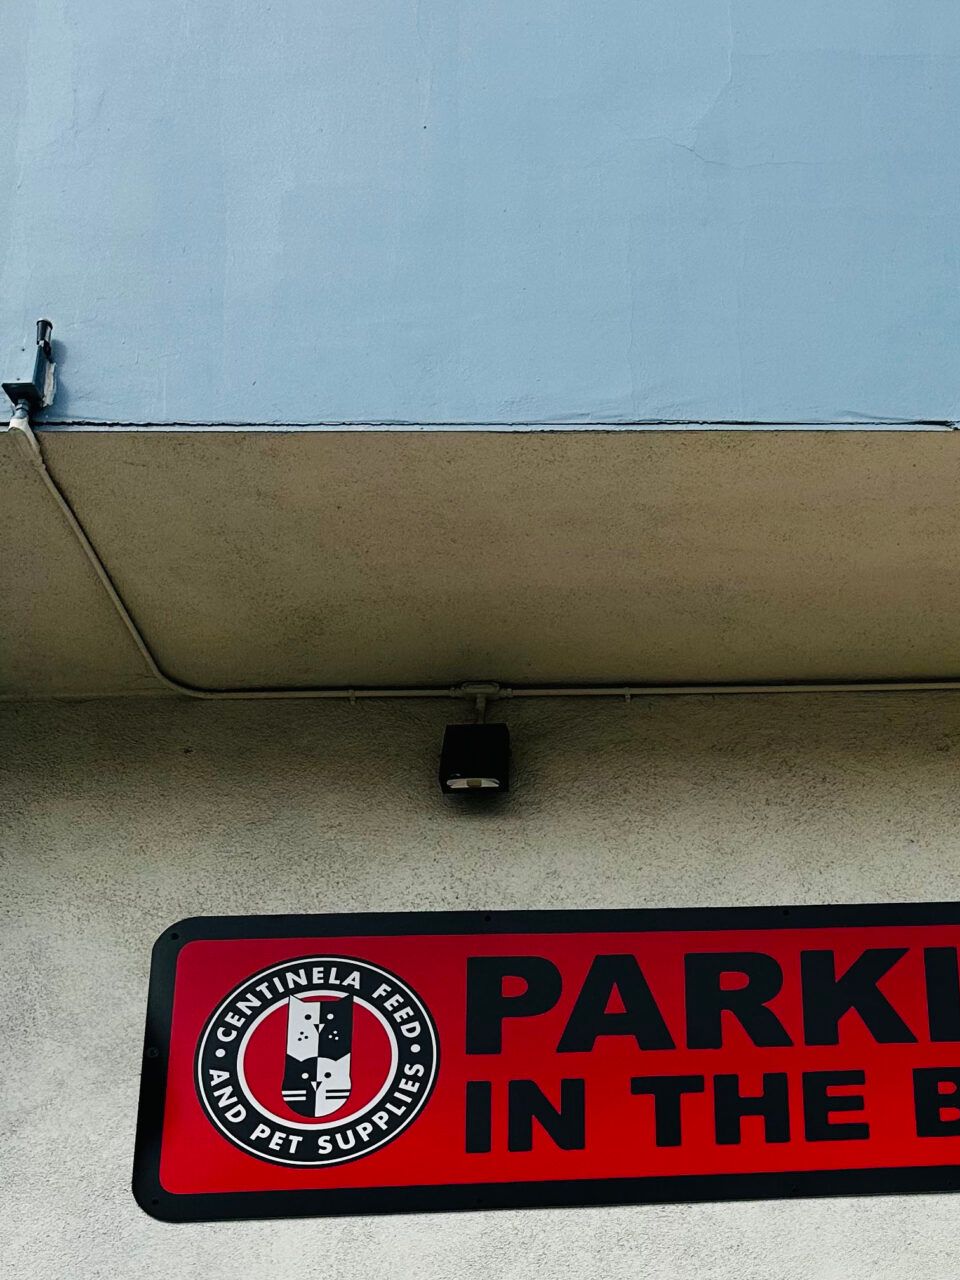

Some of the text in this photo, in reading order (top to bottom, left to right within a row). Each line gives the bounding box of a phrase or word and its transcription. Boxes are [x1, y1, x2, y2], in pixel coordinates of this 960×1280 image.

[216, 966, 421, 1043] CENTINELA FEED
[208, 1062, 425, 1156] AND PET SUPPLIES
[465, 1079, 585, 1154] IN
[630, 1069, 870, 1148] THE
